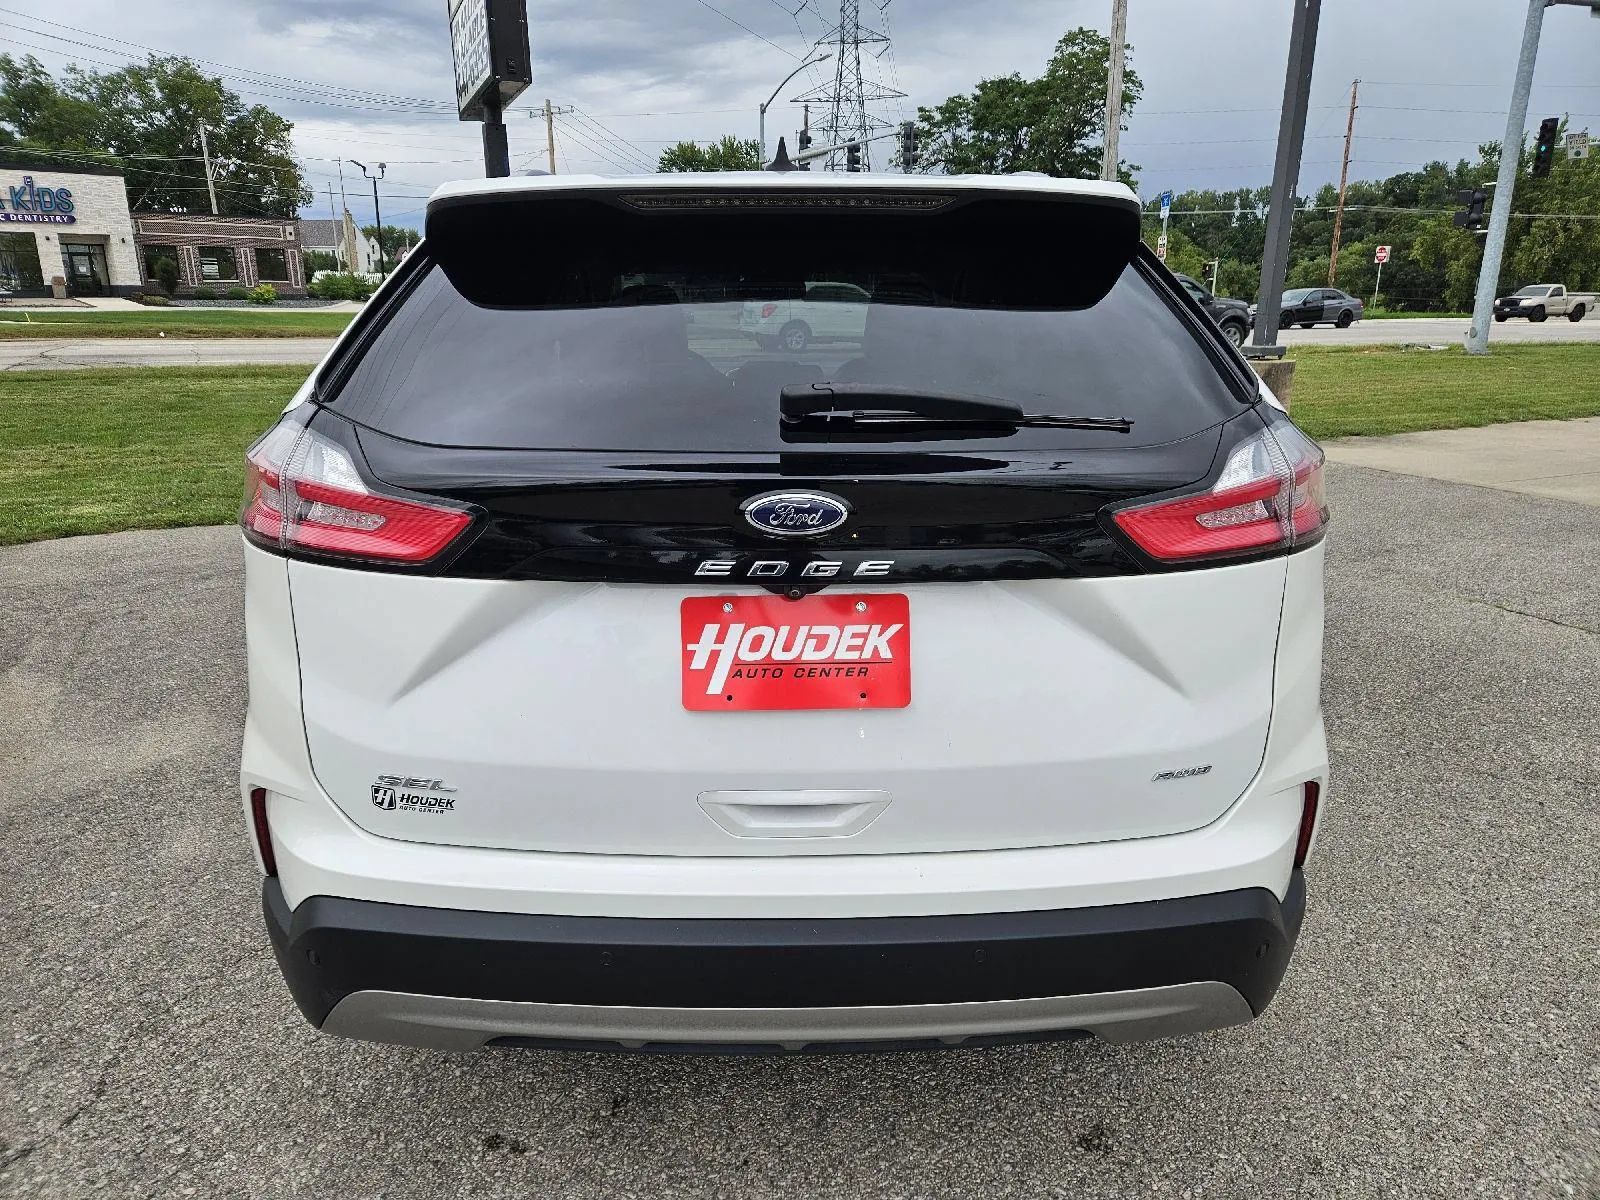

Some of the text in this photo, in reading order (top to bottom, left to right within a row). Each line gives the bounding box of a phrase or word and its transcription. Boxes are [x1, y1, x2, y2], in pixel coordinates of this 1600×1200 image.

[9, 176, 74, 212] KIDS
[10, 214, 68, 222] DENTISTRY
[769, 502, 823, 527] Ford
[694, 560, 895, 577] EDGE
[687, 623, 904, 695] HOUDEK
[732, 667, 869, 679] AUTO CENTER
[375, 775, 458, 792] SEL
[399, 793, 456, 809] HOUDEK
